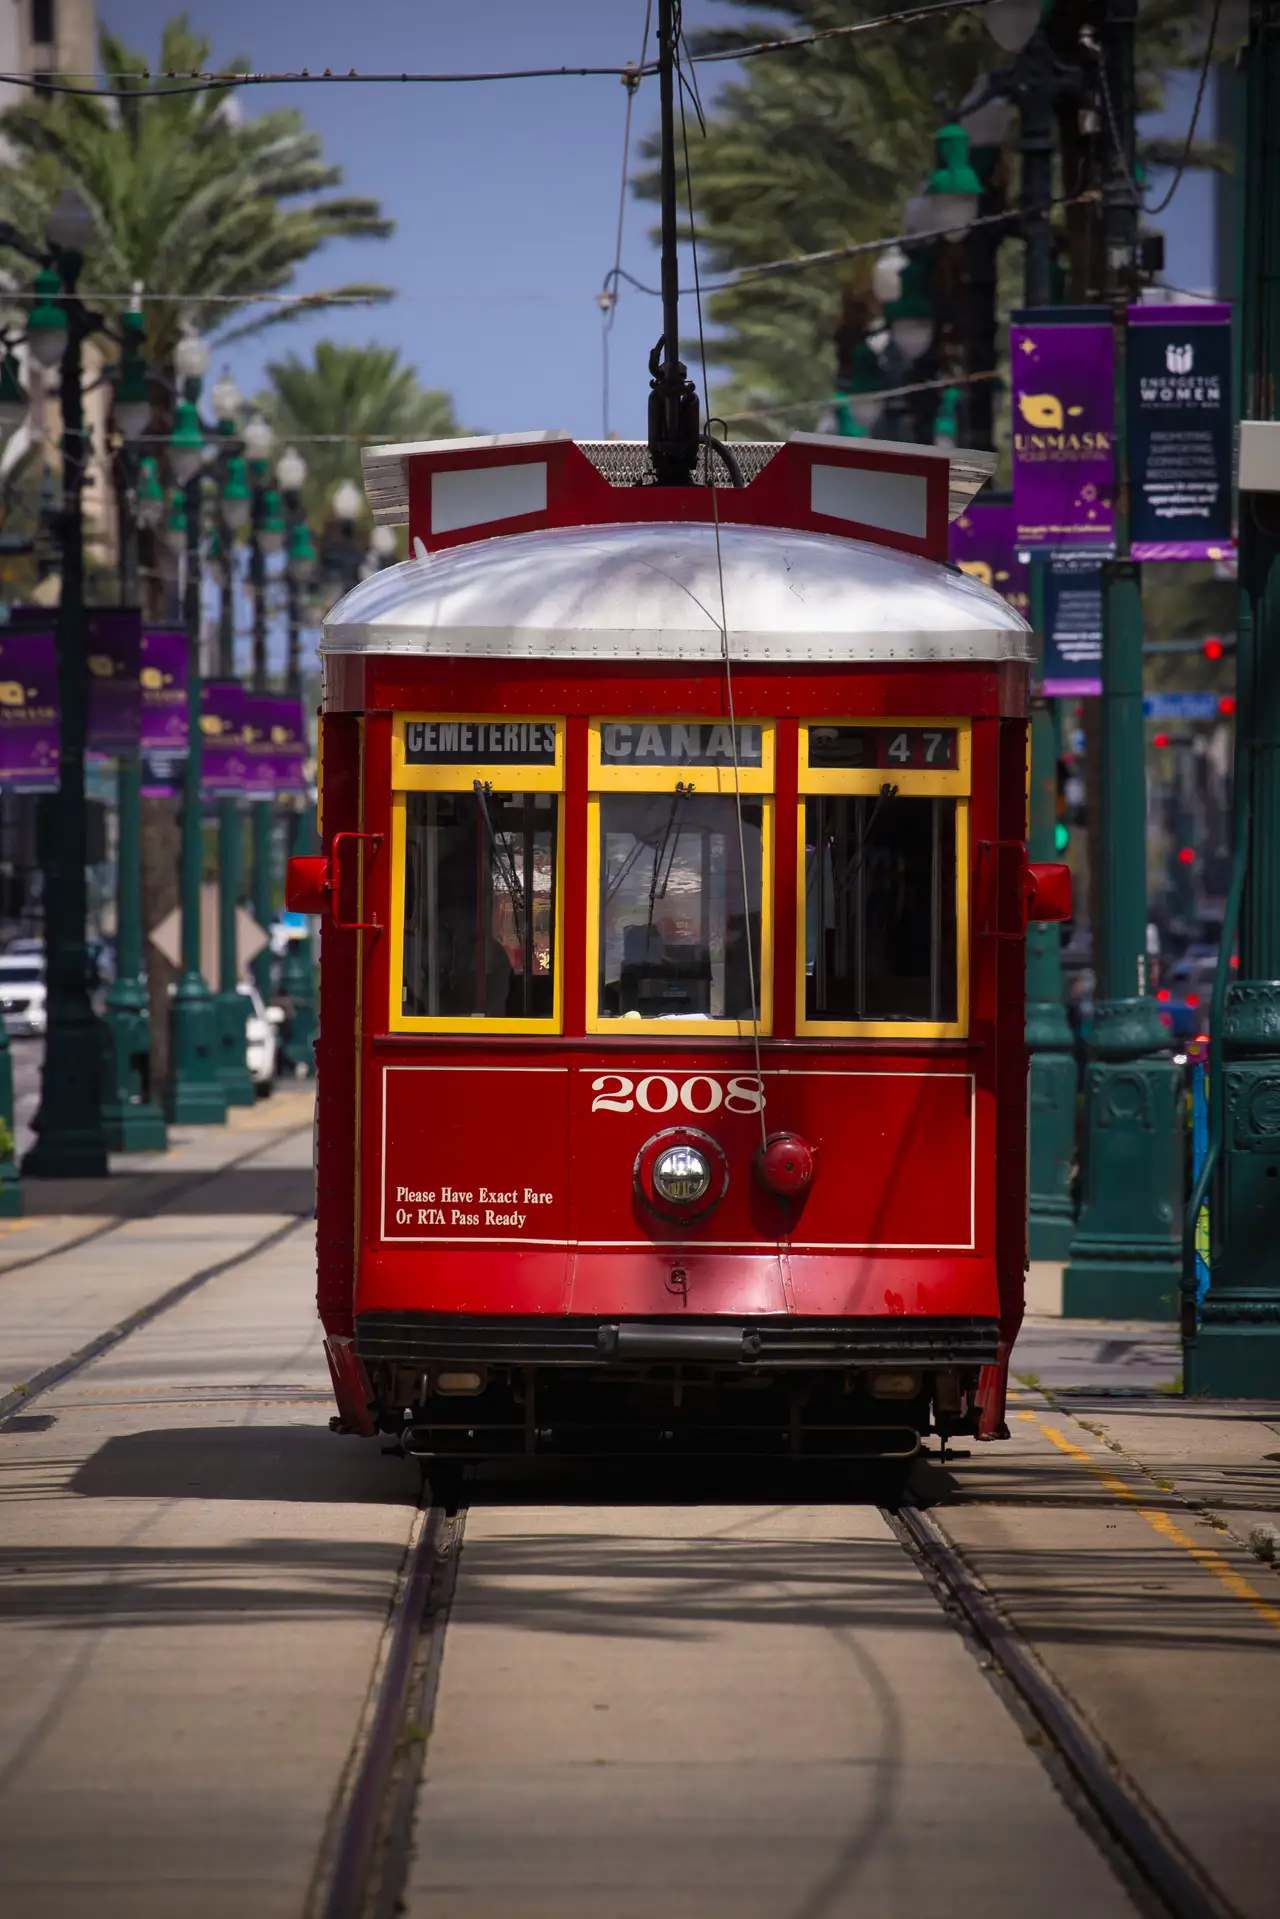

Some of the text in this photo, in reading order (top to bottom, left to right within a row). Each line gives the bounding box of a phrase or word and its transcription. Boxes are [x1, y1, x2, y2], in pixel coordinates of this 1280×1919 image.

[1140, 387, 1221, 401] WOMEN
[1014, 432, 1110, 450] UNMASK
[407, 722, 556, 753] CEMETERIES
[603, 723, 762, 757] CANAL
[591, 1075, 767, 1114] 2008
[396, 1186, 553, 1204] Please Have Exact Fare
[395, 1208, 526, 1228] Or RTA Pass Ready
